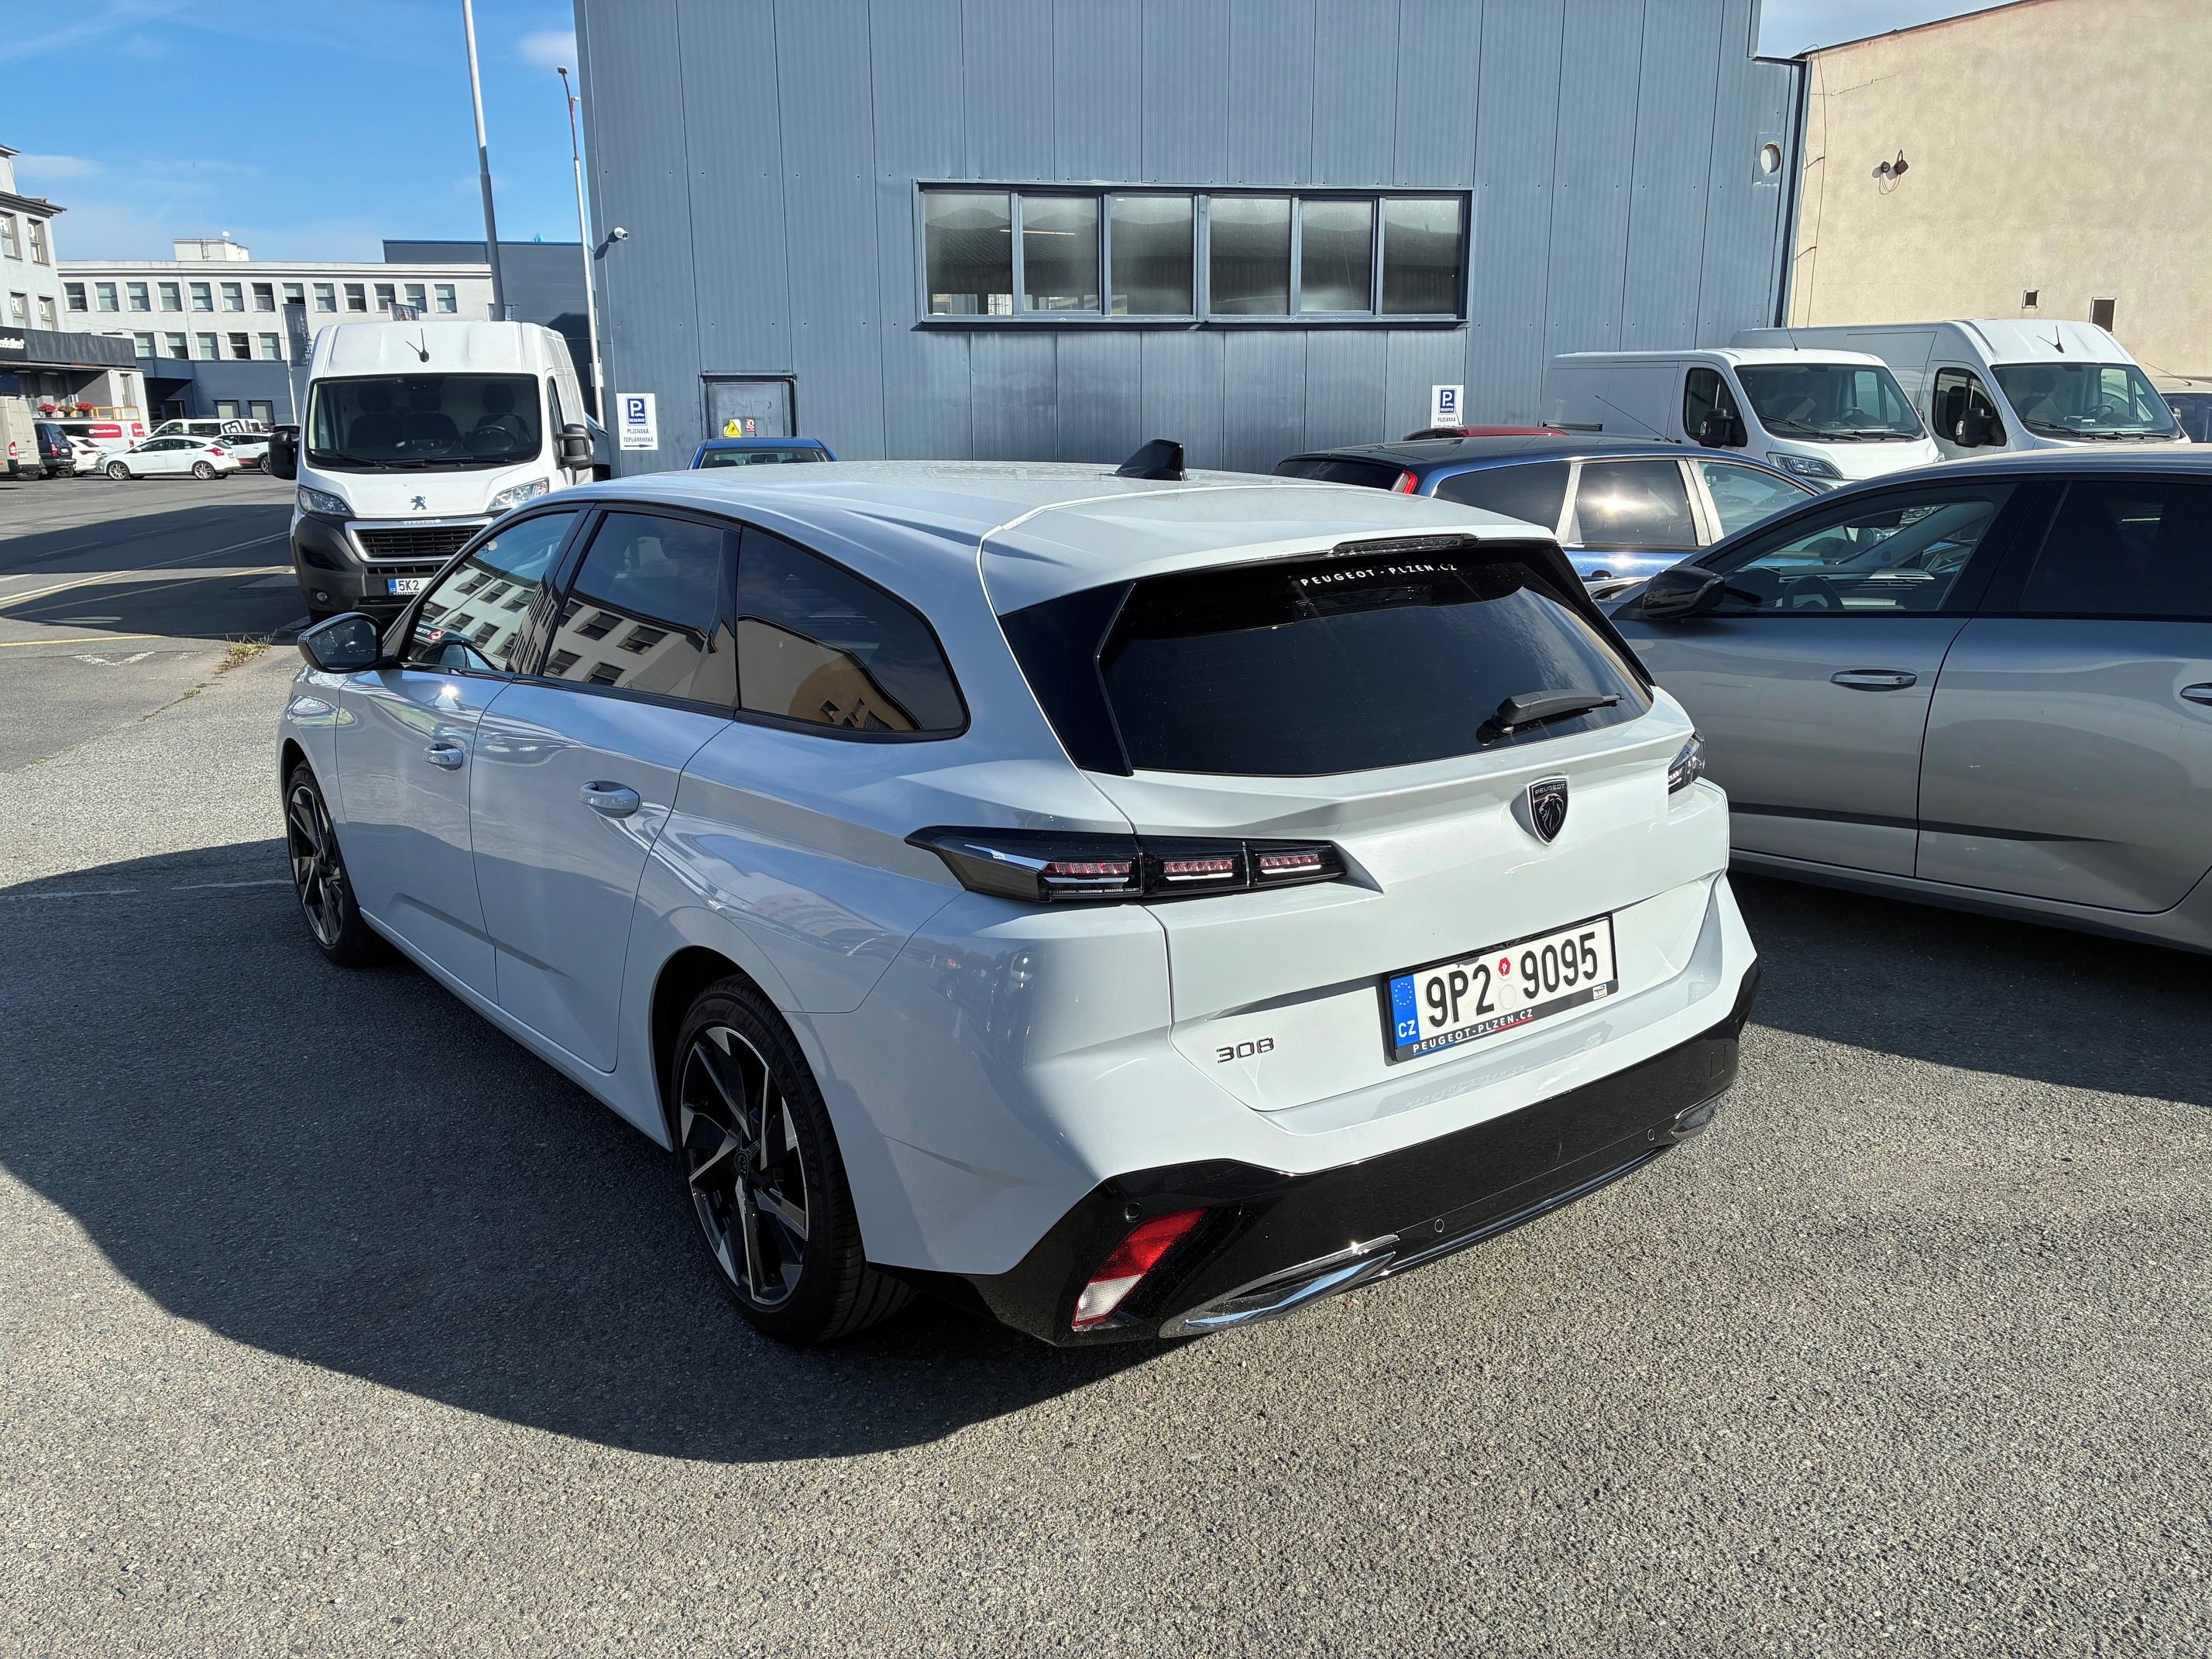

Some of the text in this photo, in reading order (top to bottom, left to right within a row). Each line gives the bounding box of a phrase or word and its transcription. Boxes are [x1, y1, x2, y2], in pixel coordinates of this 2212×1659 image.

[1442, 391, 1452, 407] P
[630, 400, 642, 417] P
[398, 579, 420, 591] 5K2
[1534, 784, 1565, 795] PEUGEOT
[1426, 931, 1598, 1028] 9P2 9095
[1398, 1019, 1417, 1039] CZ
[1413, 1008, 1534, 1053] PEUGEOT-PLZEN.CZ
[1216, 1037, 1274, 1063] 308
